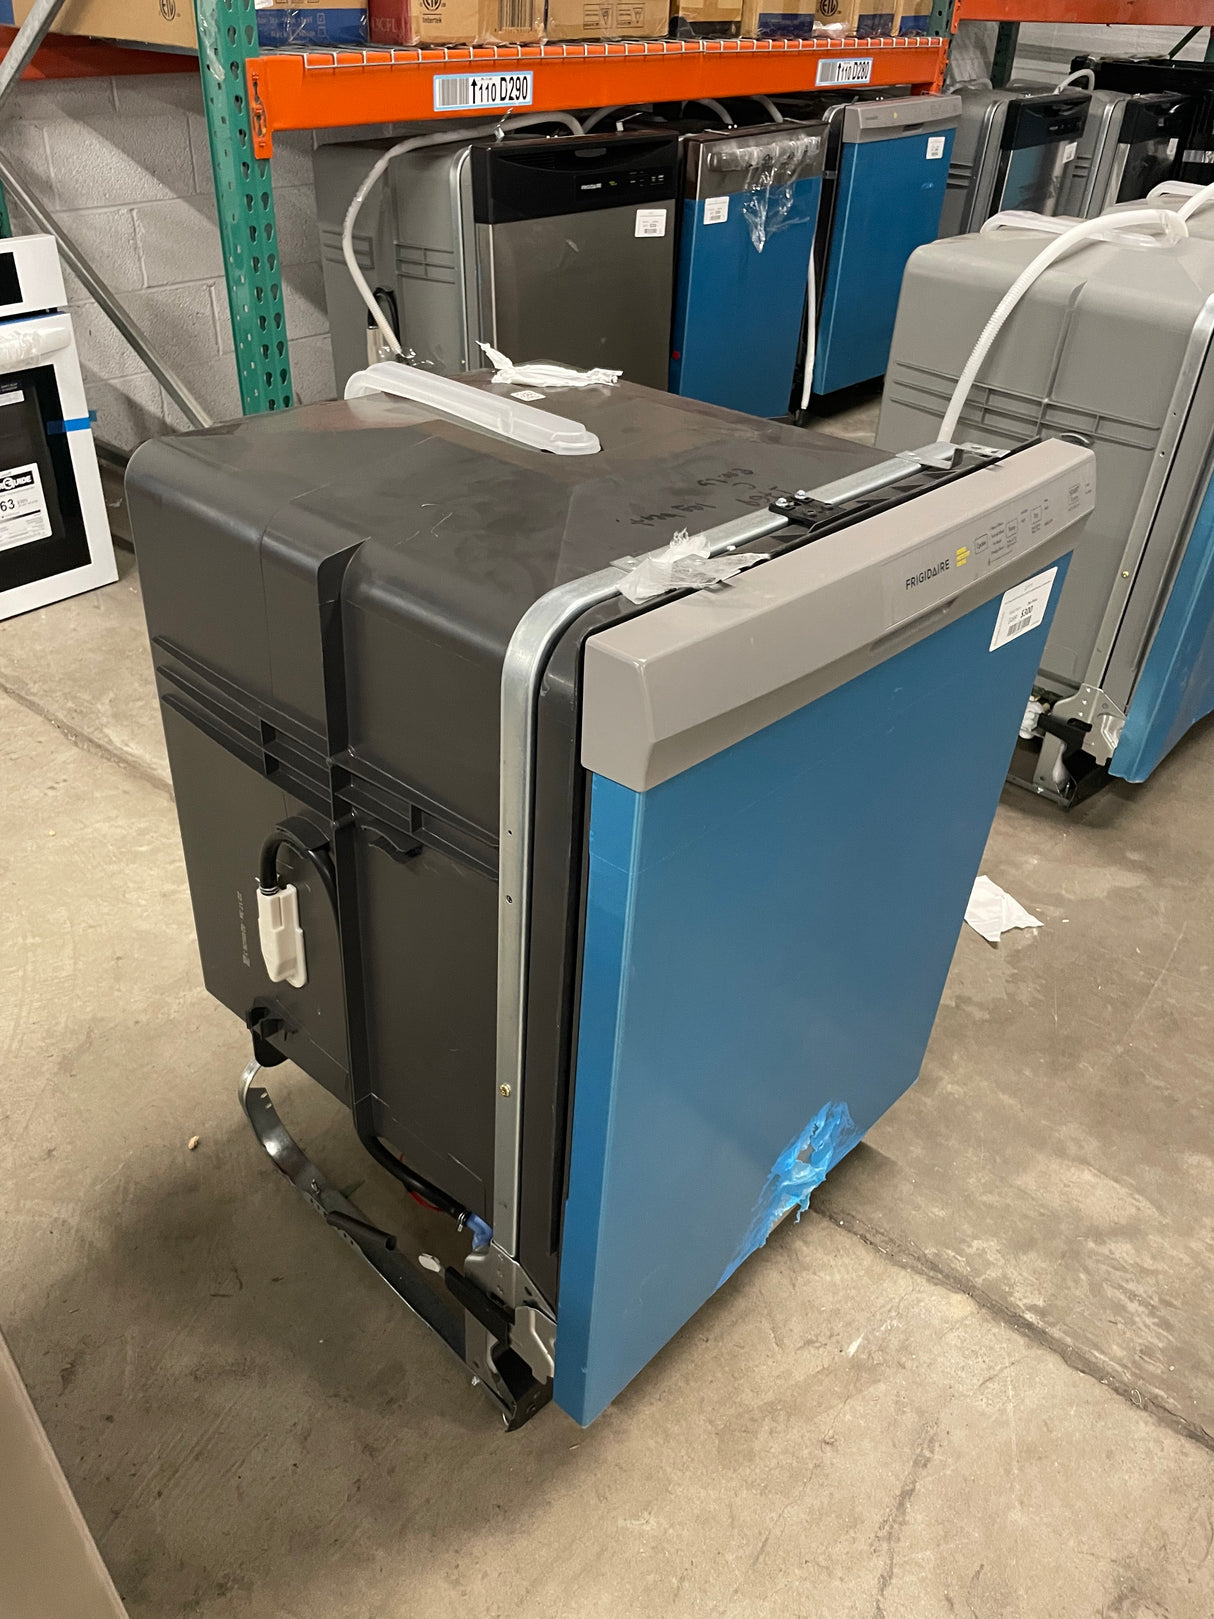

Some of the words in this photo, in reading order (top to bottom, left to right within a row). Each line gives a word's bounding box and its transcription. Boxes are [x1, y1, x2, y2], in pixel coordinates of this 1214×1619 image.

[852, 61, 870, 80] D280
[478, 83, 497, 103] 110
[499, 76, 528, 102] D290
[905, 558, 950, 591] FRIGIDAIRE
